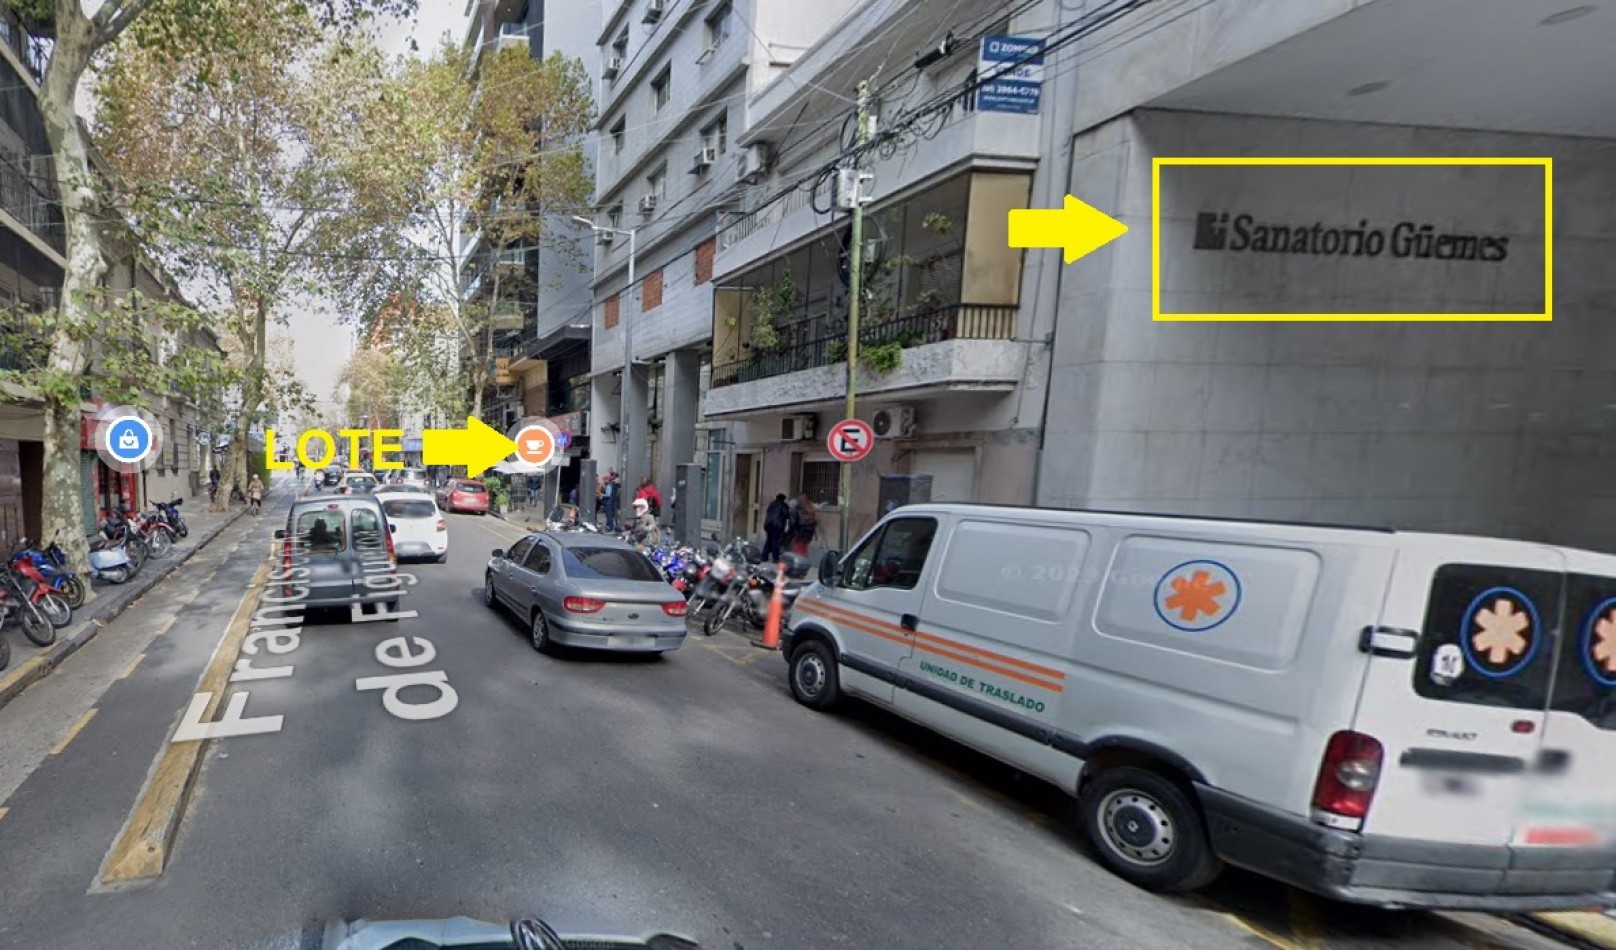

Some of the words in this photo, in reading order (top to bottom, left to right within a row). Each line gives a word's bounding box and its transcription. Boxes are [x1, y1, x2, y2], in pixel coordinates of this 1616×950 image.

[1230, 213, 1385, 258] Sanatorio
[1391, 221, 1510, 262] Güemes
[919, 660, 958, 682] UNIDAD
[960, 675, 976, 689] DE
[979, 681, 1046, 713] TRASLADO
